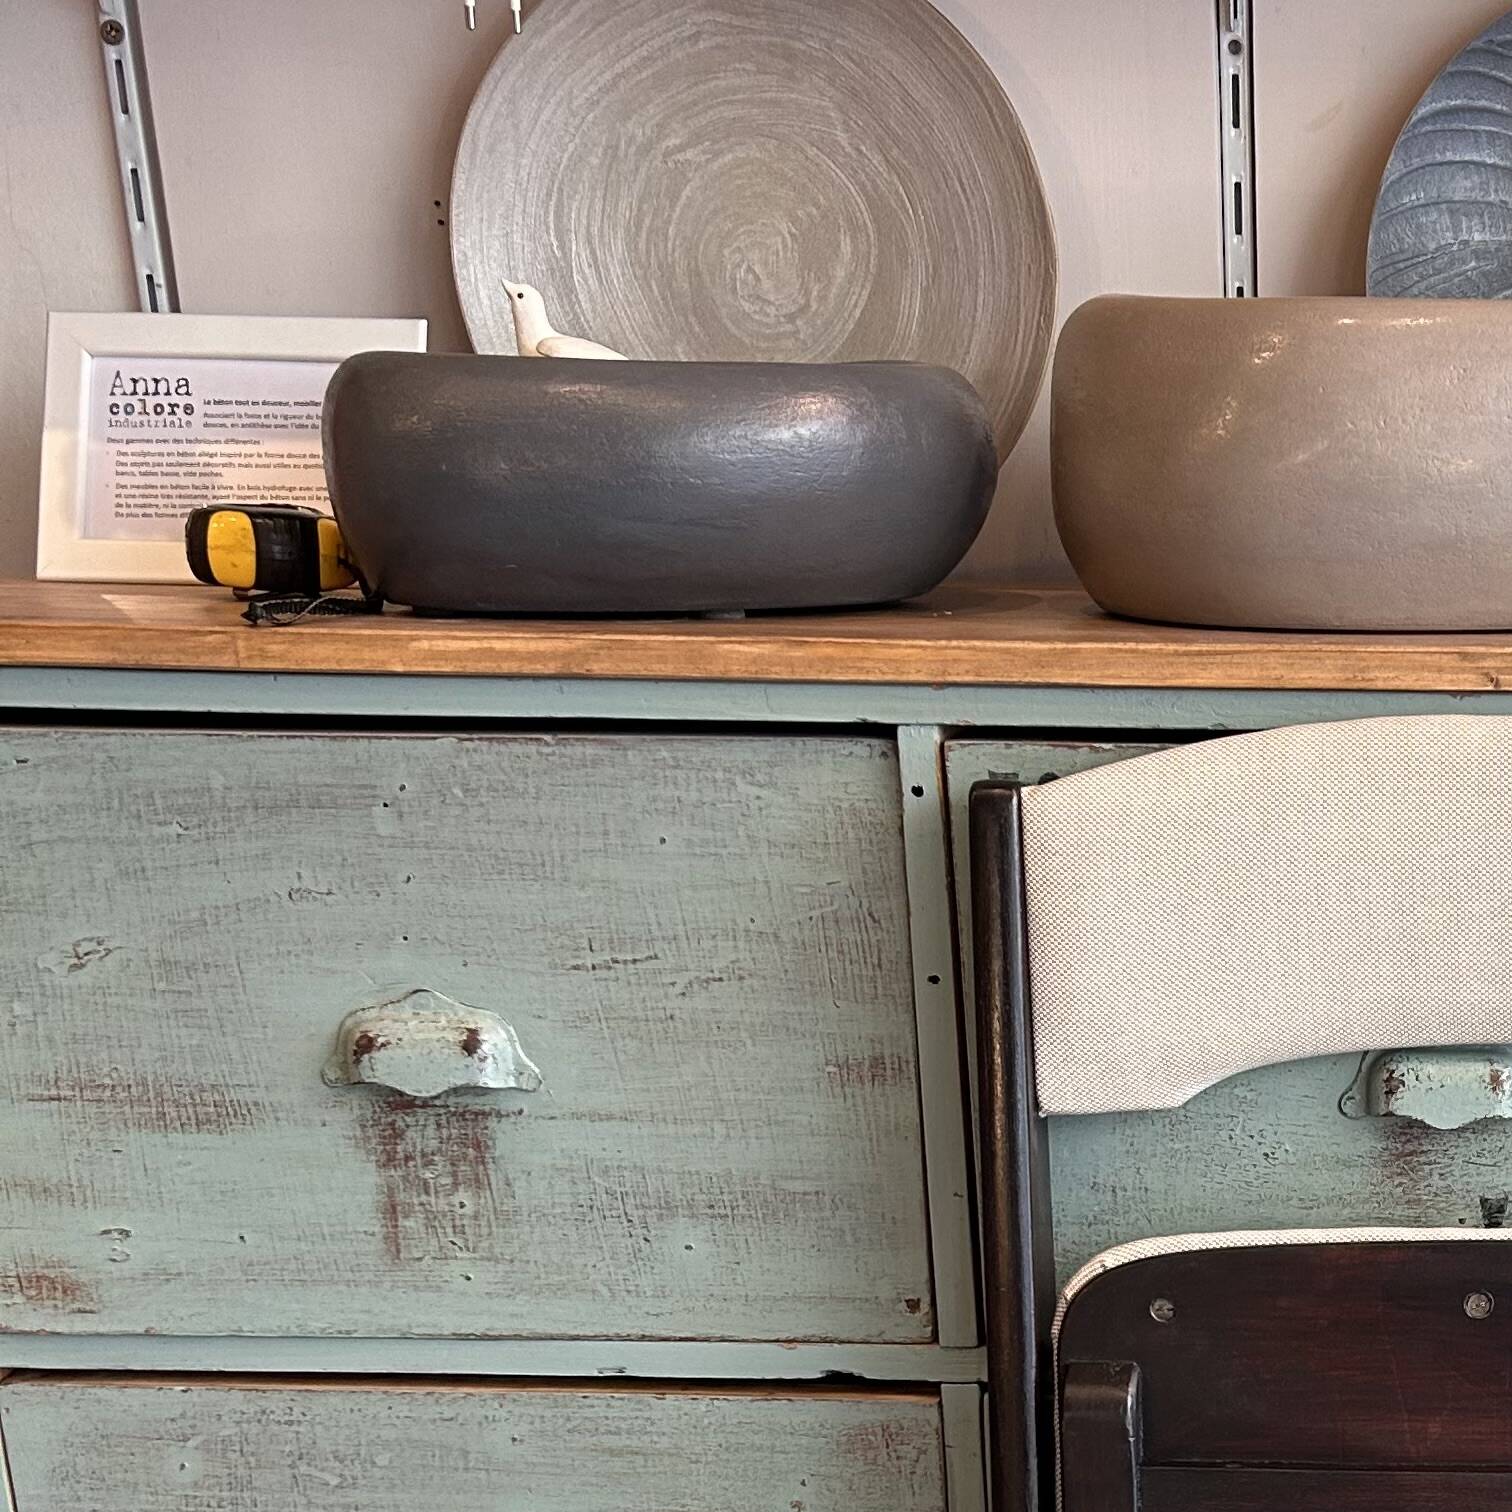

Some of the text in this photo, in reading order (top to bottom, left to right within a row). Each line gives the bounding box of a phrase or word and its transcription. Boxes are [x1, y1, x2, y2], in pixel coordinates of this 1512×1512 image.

[109, 369, 192, 397] Anna
[109, 398, 195, 416] colore
[107, 417, 193, 429] industriale
